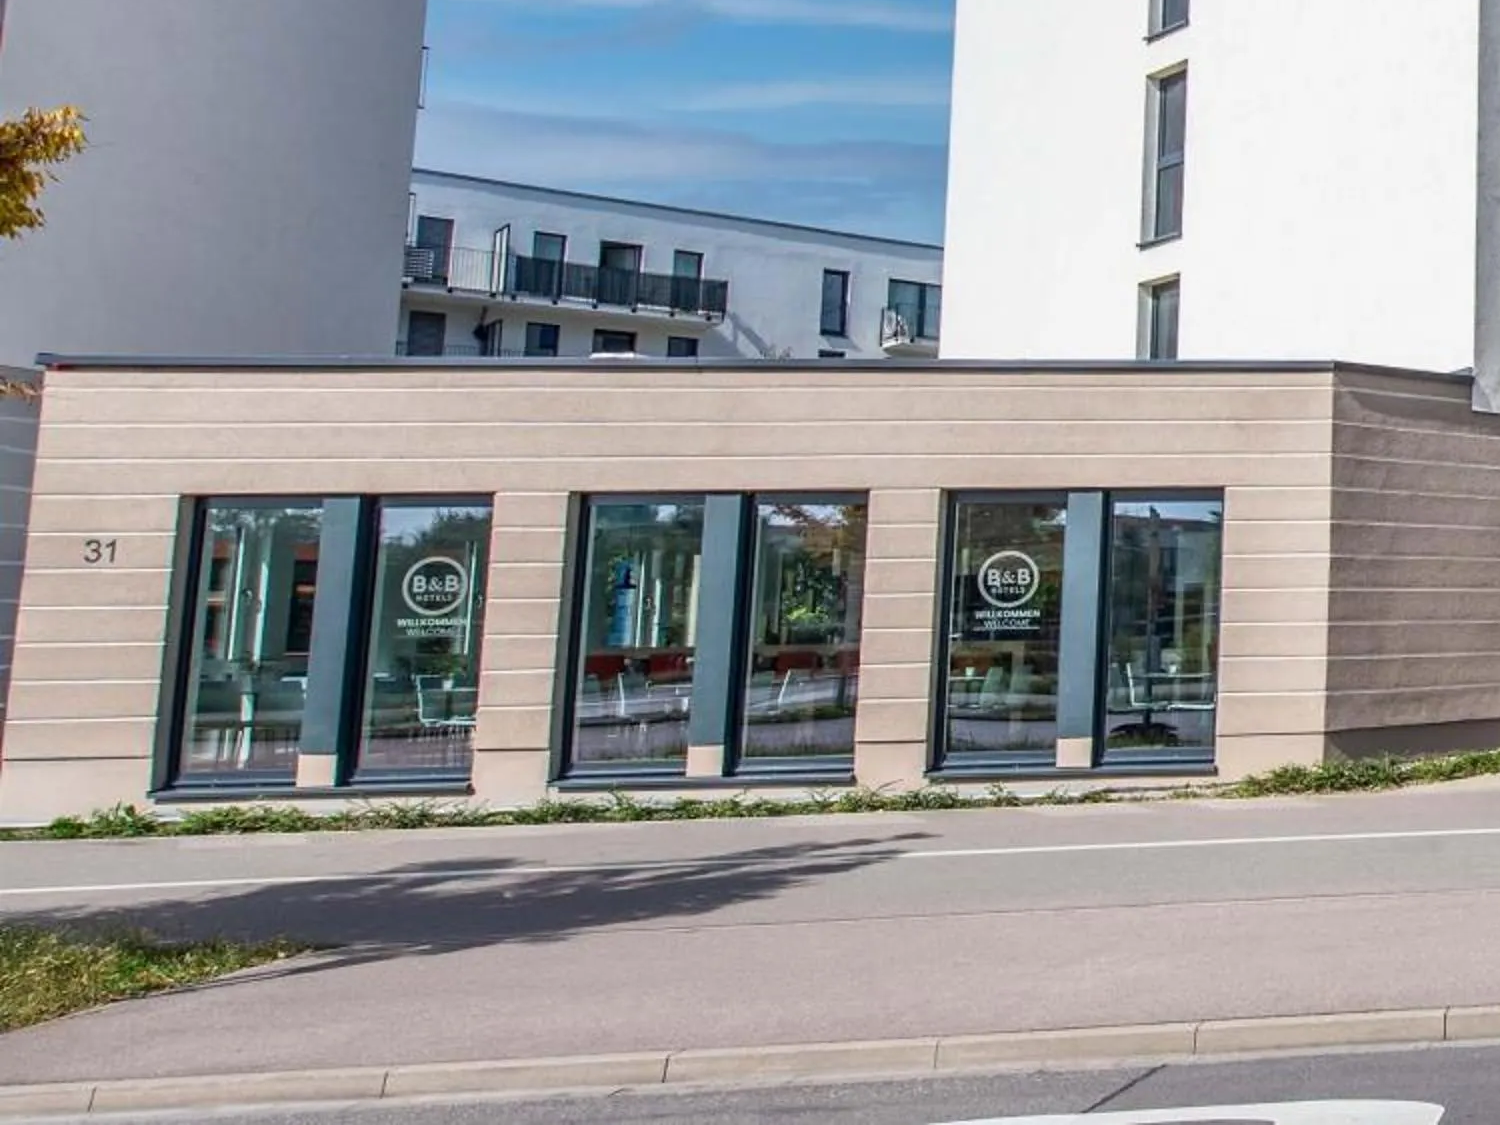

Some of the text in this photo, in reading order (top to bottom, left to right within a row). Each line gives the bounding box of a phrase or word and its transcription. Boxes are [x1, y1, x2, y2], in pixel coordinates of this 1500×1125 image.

[84, 539, 117, 563] 31
[412, 575, 459, 593] B&B
[987, 568, 1031, 586] B&B
